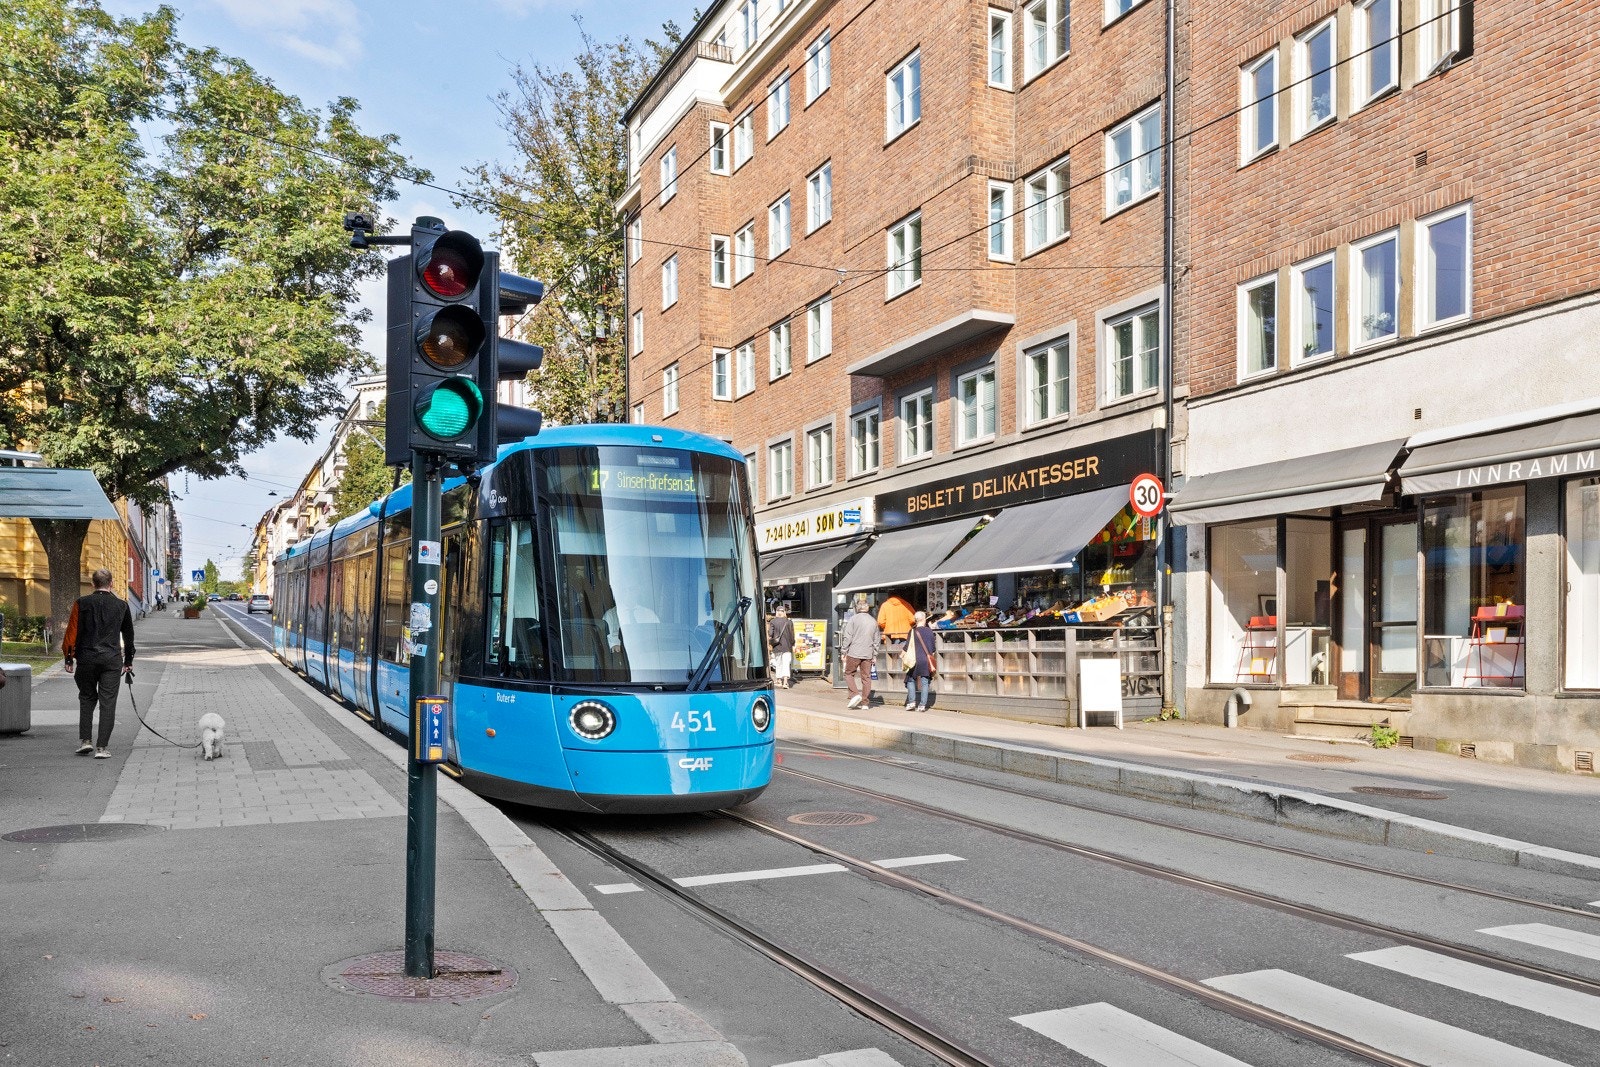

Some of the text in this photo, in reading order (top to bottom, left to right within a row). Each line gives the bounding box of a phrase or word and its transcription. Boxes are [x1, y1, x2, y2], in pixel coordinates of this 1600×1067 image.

[591, 469, 610, 490] 17
[1456, 451, 1595, 487] INNRAMM
[907, 455, 1100, 514] BISLETT DELIKATESSER
[1136, 484, 1158, 506] 30
[670, 710, 717, 733] 451
[678, 757, 714, 772] CAF
